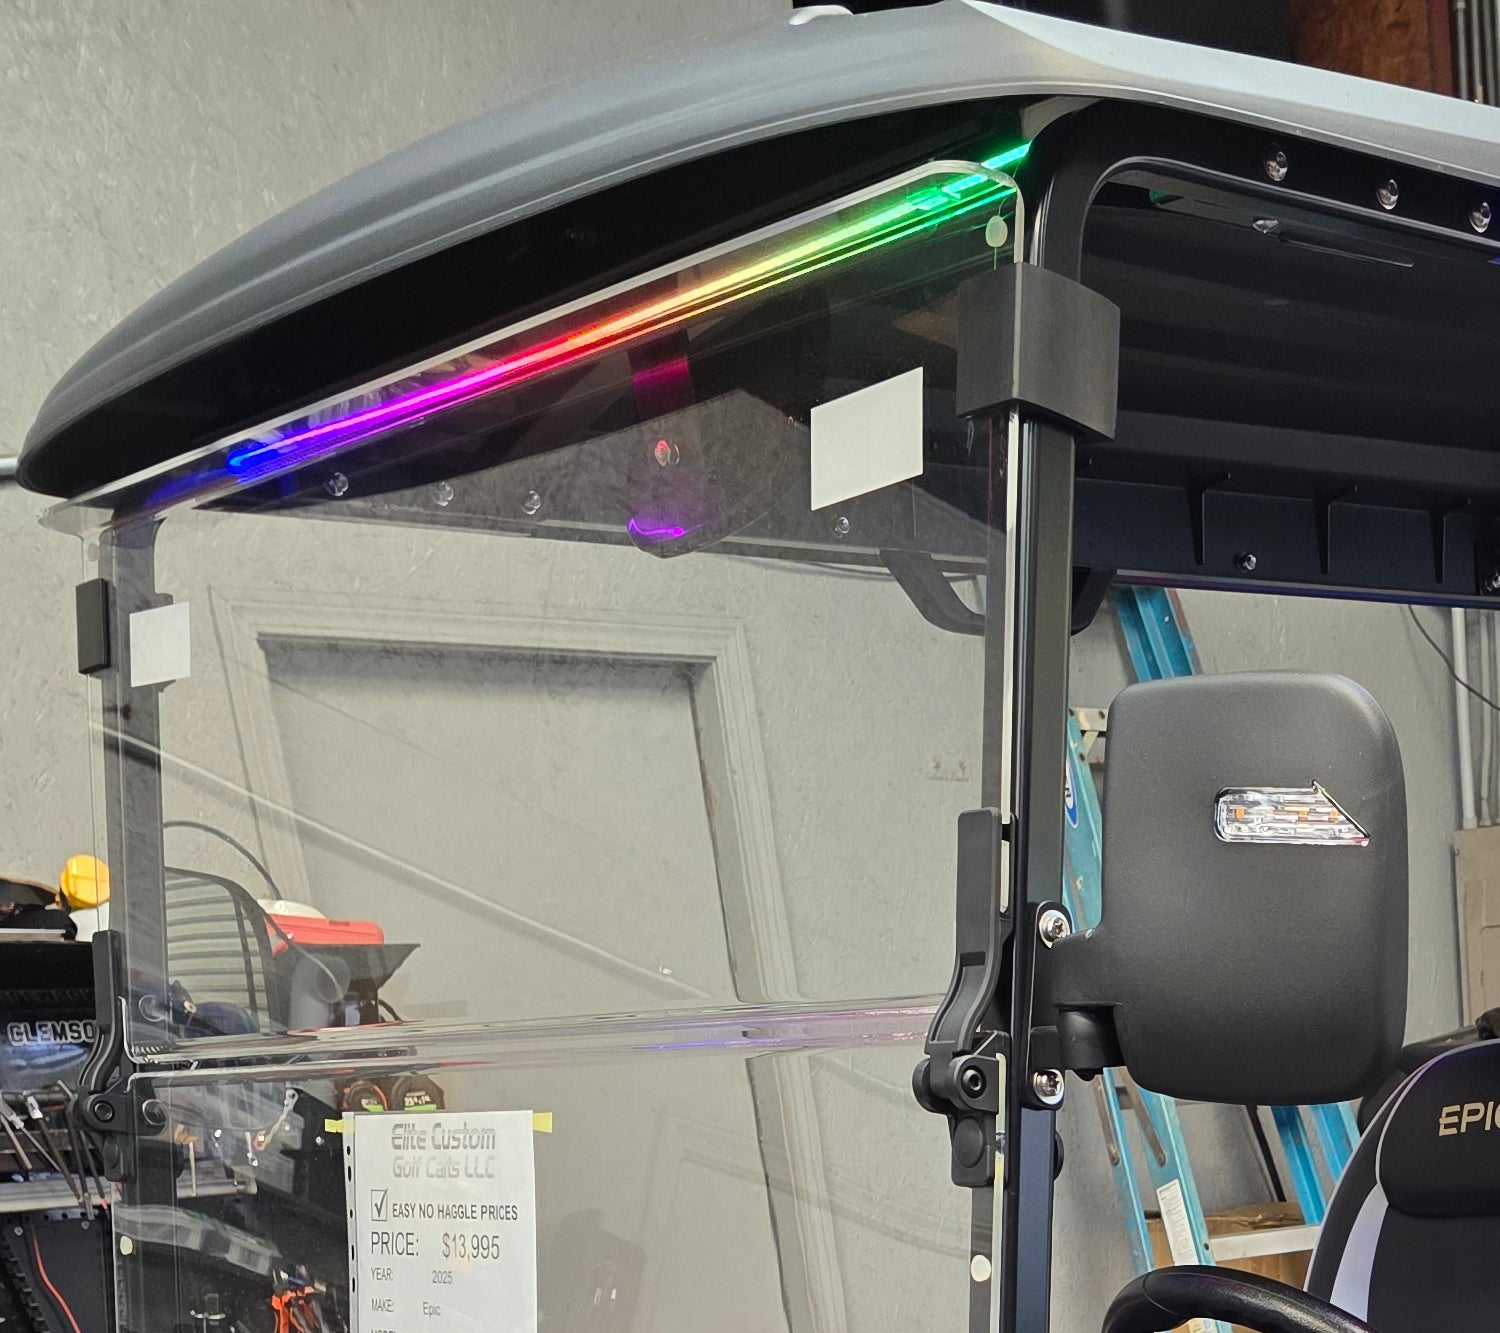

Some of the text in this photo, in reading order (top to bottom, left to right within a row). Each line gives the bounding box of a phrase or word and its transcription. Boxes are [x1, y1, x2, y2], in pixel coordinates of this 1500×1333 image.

[7, 1019, 96, 1047] CLEMSO
[391, 1121, 496, 1150] Elite Custom
[392, 1155, 496, 1179] Golf Carts LLC
[392, 1203, 518, 1221] EASY NO HAGGLE PRICES
[371, 1231, 500, 1262] PRICE: $13,995
[371, 1267, 453, 1285] YEAR: 2025
[371, 1298, 442, 1318] MAKE: Epic
